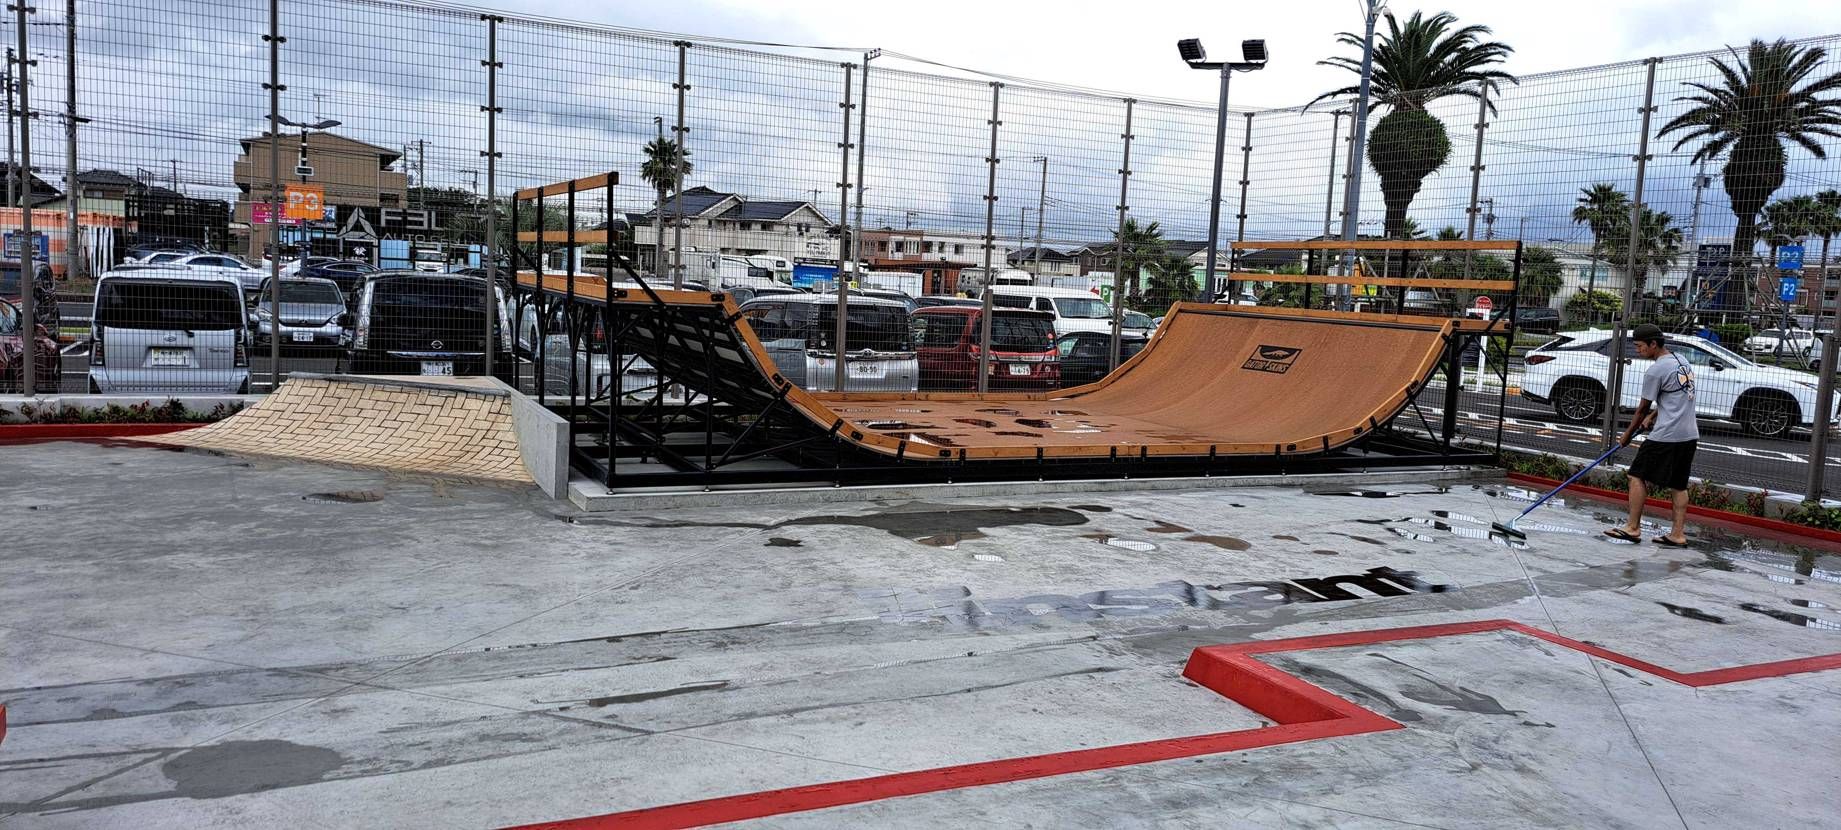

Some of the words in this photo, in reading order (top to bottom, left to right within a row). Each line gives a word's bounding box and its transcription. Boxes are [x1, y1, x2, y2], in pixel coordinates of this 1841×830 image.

[289, 191, 320, 212] P3
[1781, 251, 1799, 263] P2
[1782, 283, 1796, 296] P2
